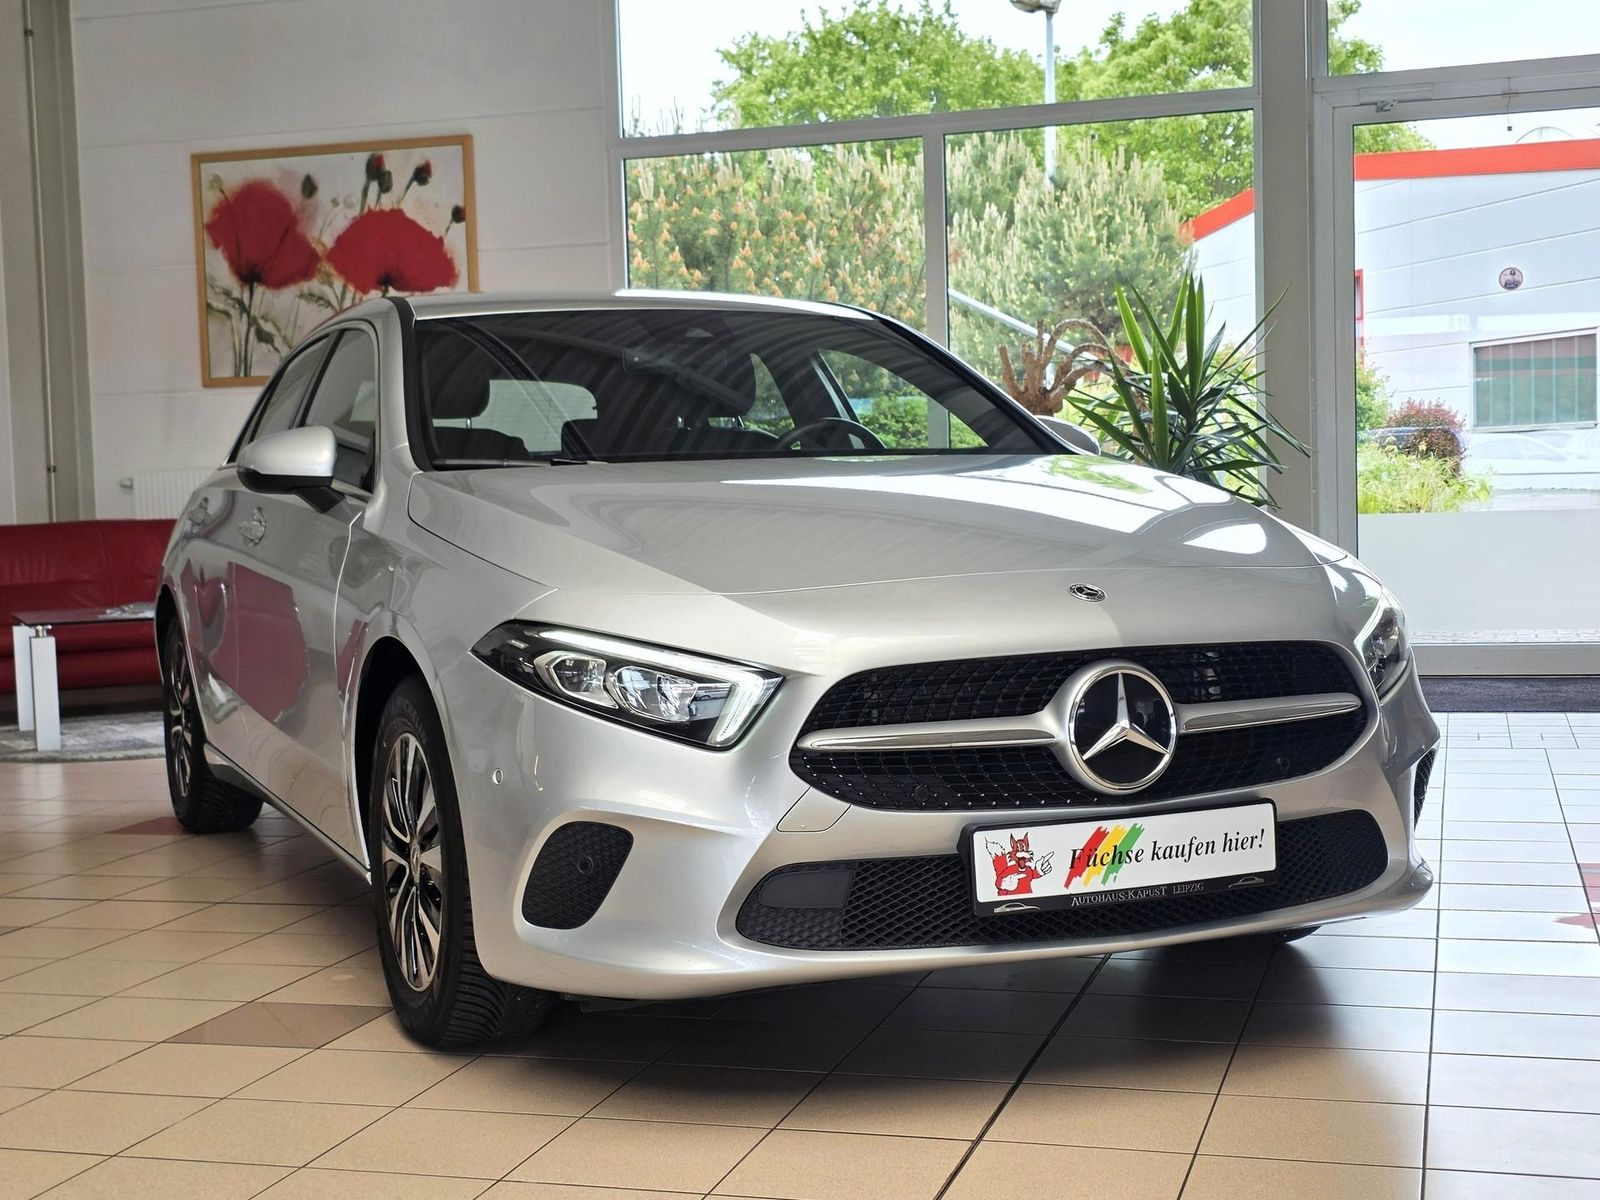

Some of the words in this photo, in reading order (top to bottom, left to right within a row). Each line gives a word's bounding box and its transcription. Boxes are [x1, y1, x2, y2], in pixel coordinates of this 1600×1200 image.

[1069, 844, 1144, 870] Füchse
[1151, 836, 1216, 862] kaufen
[1222, 828, 1265, 853] hier!
[1173, 883, 1204, 894] LEIPZIG
